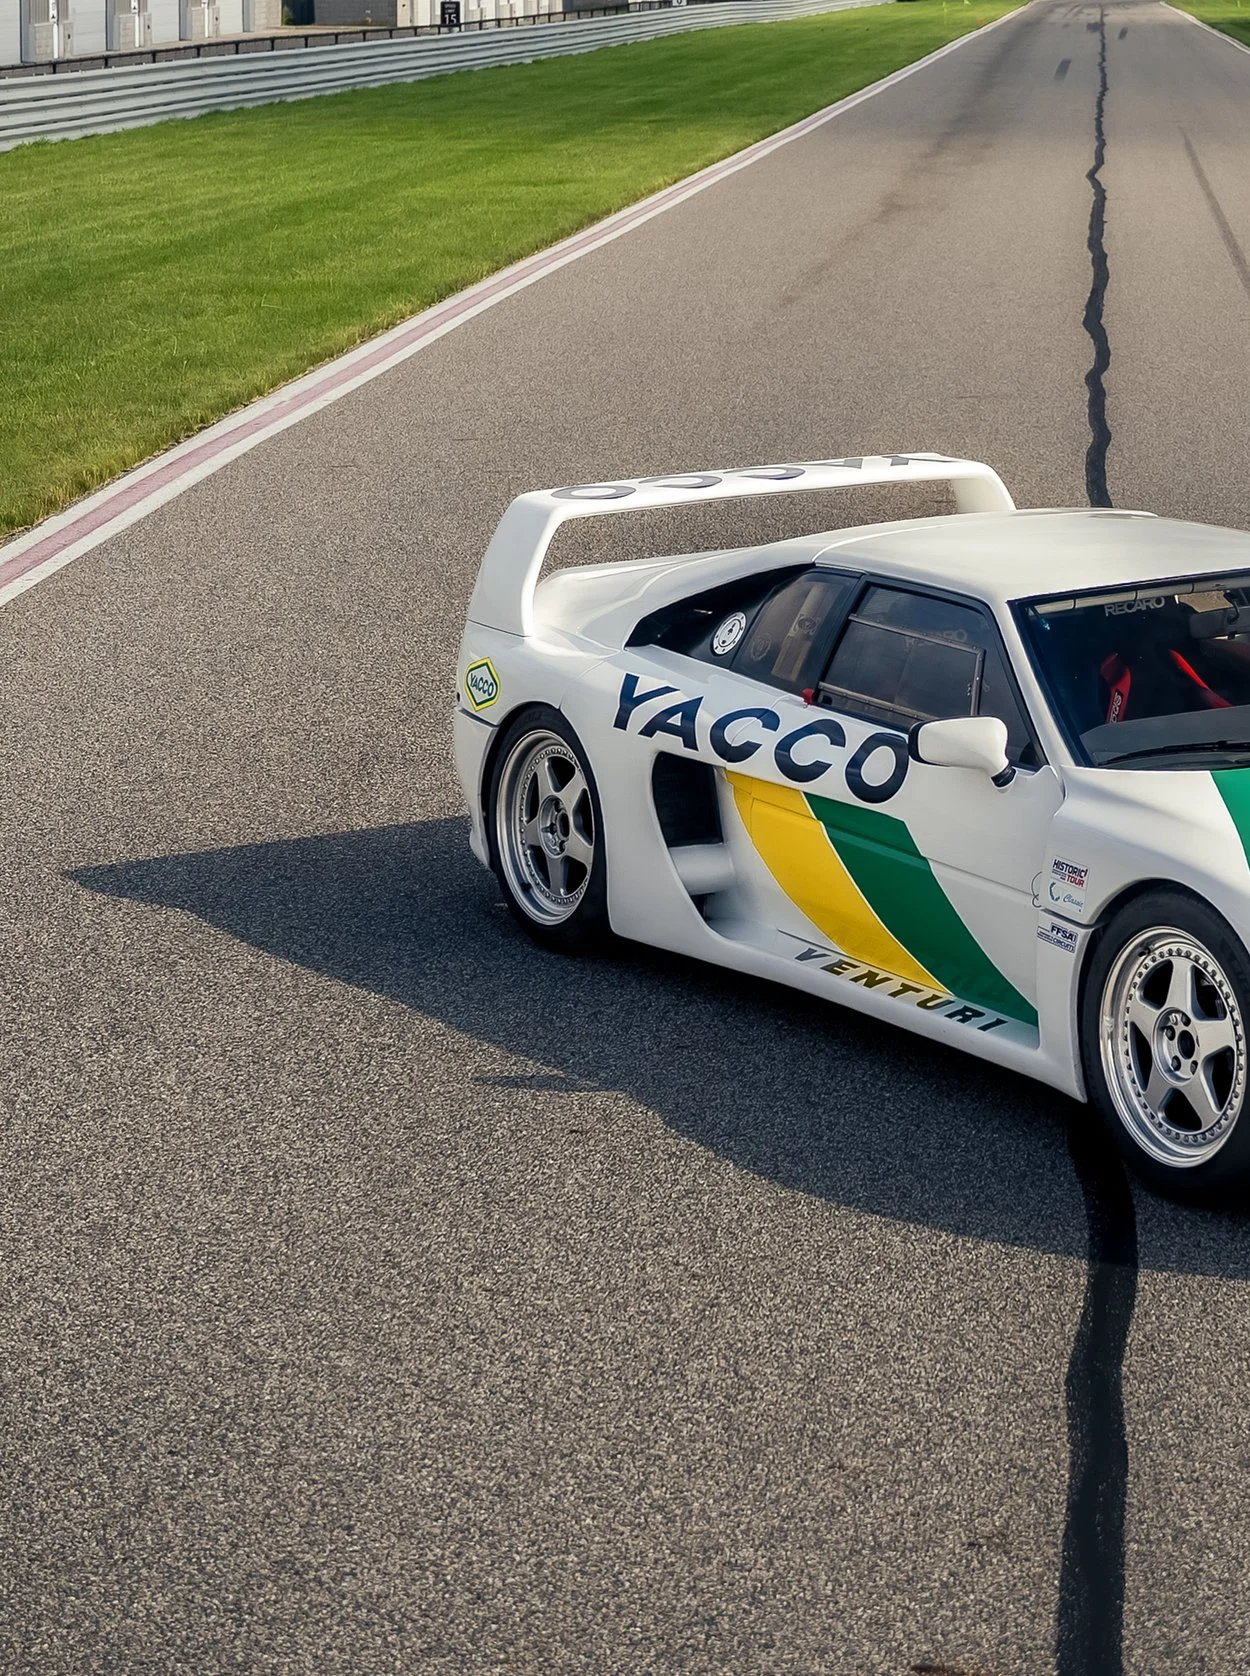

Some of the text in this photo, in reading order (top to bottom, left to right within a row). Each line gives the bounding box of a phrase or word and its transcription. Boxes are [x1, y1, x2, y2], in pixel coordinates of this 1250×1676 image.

[444, 14, 456, 24] 15
[1104, 597, 1165, 616] RECARO
[470, 673, 494, 697] YACCO
[613, 673, 909, 804] YACCO
[1066, 875, 1085, 888] TOUR
[794, 947, 1008, 1032] VENTURI
